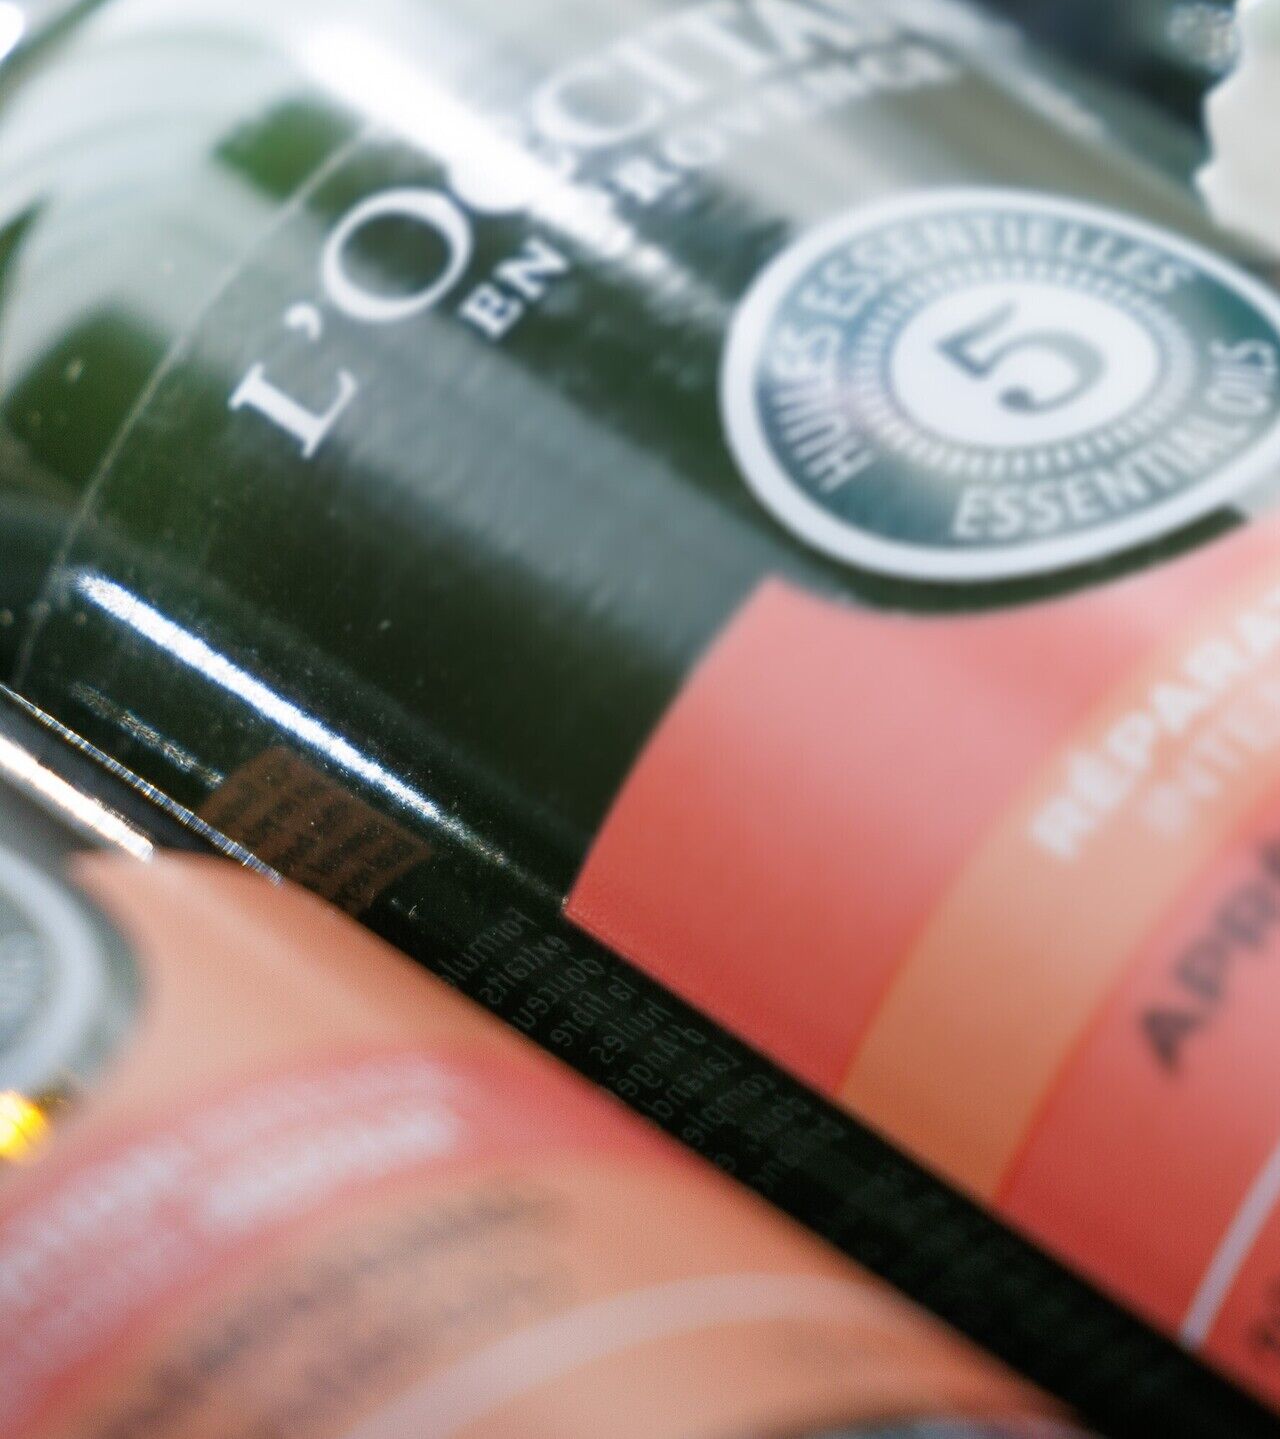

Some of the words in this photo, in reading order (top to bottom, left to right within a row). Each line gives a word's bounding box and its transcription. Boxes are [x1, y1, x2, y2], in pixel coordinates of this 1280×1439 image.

[457, 236, 572, 341] EN
[802, 213, 1192, 322] ESSENTIELLES
[932, 299, 1108, 415] 5
[952, 413, 1250, 540] ESSENTIAL
[1204, 337, 1280, 417] OILS
